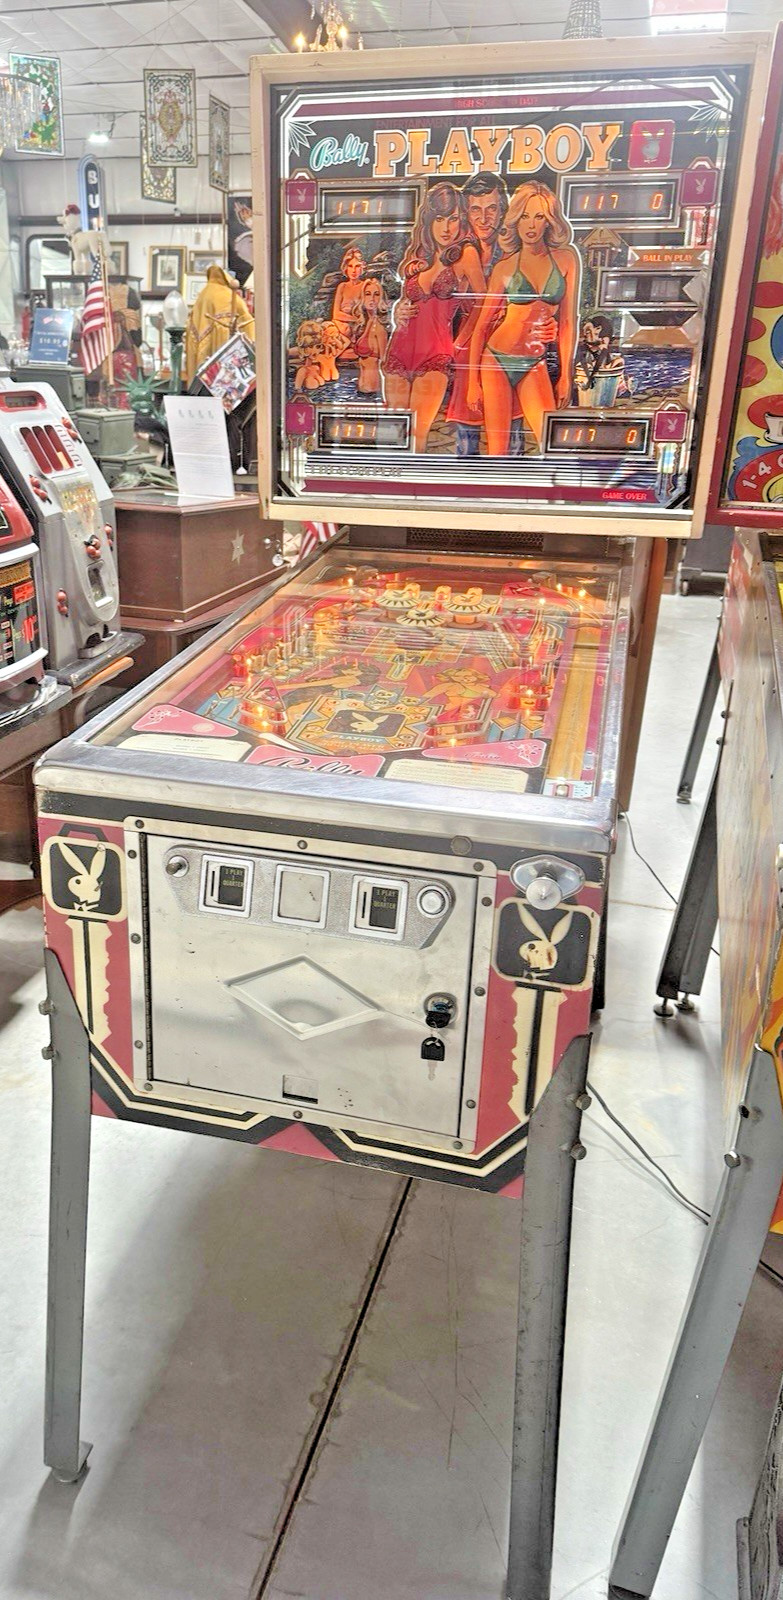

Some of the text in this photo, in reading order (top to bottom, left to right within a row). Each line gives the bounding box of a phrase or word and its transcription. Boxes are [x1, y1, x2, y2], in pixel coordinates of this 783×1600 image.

[373, 120, 624, 177] PLAYBOY
[643, 253, 694, 262] BALL IN PLAY
[602, 491, 647, 501] GAME OVER
